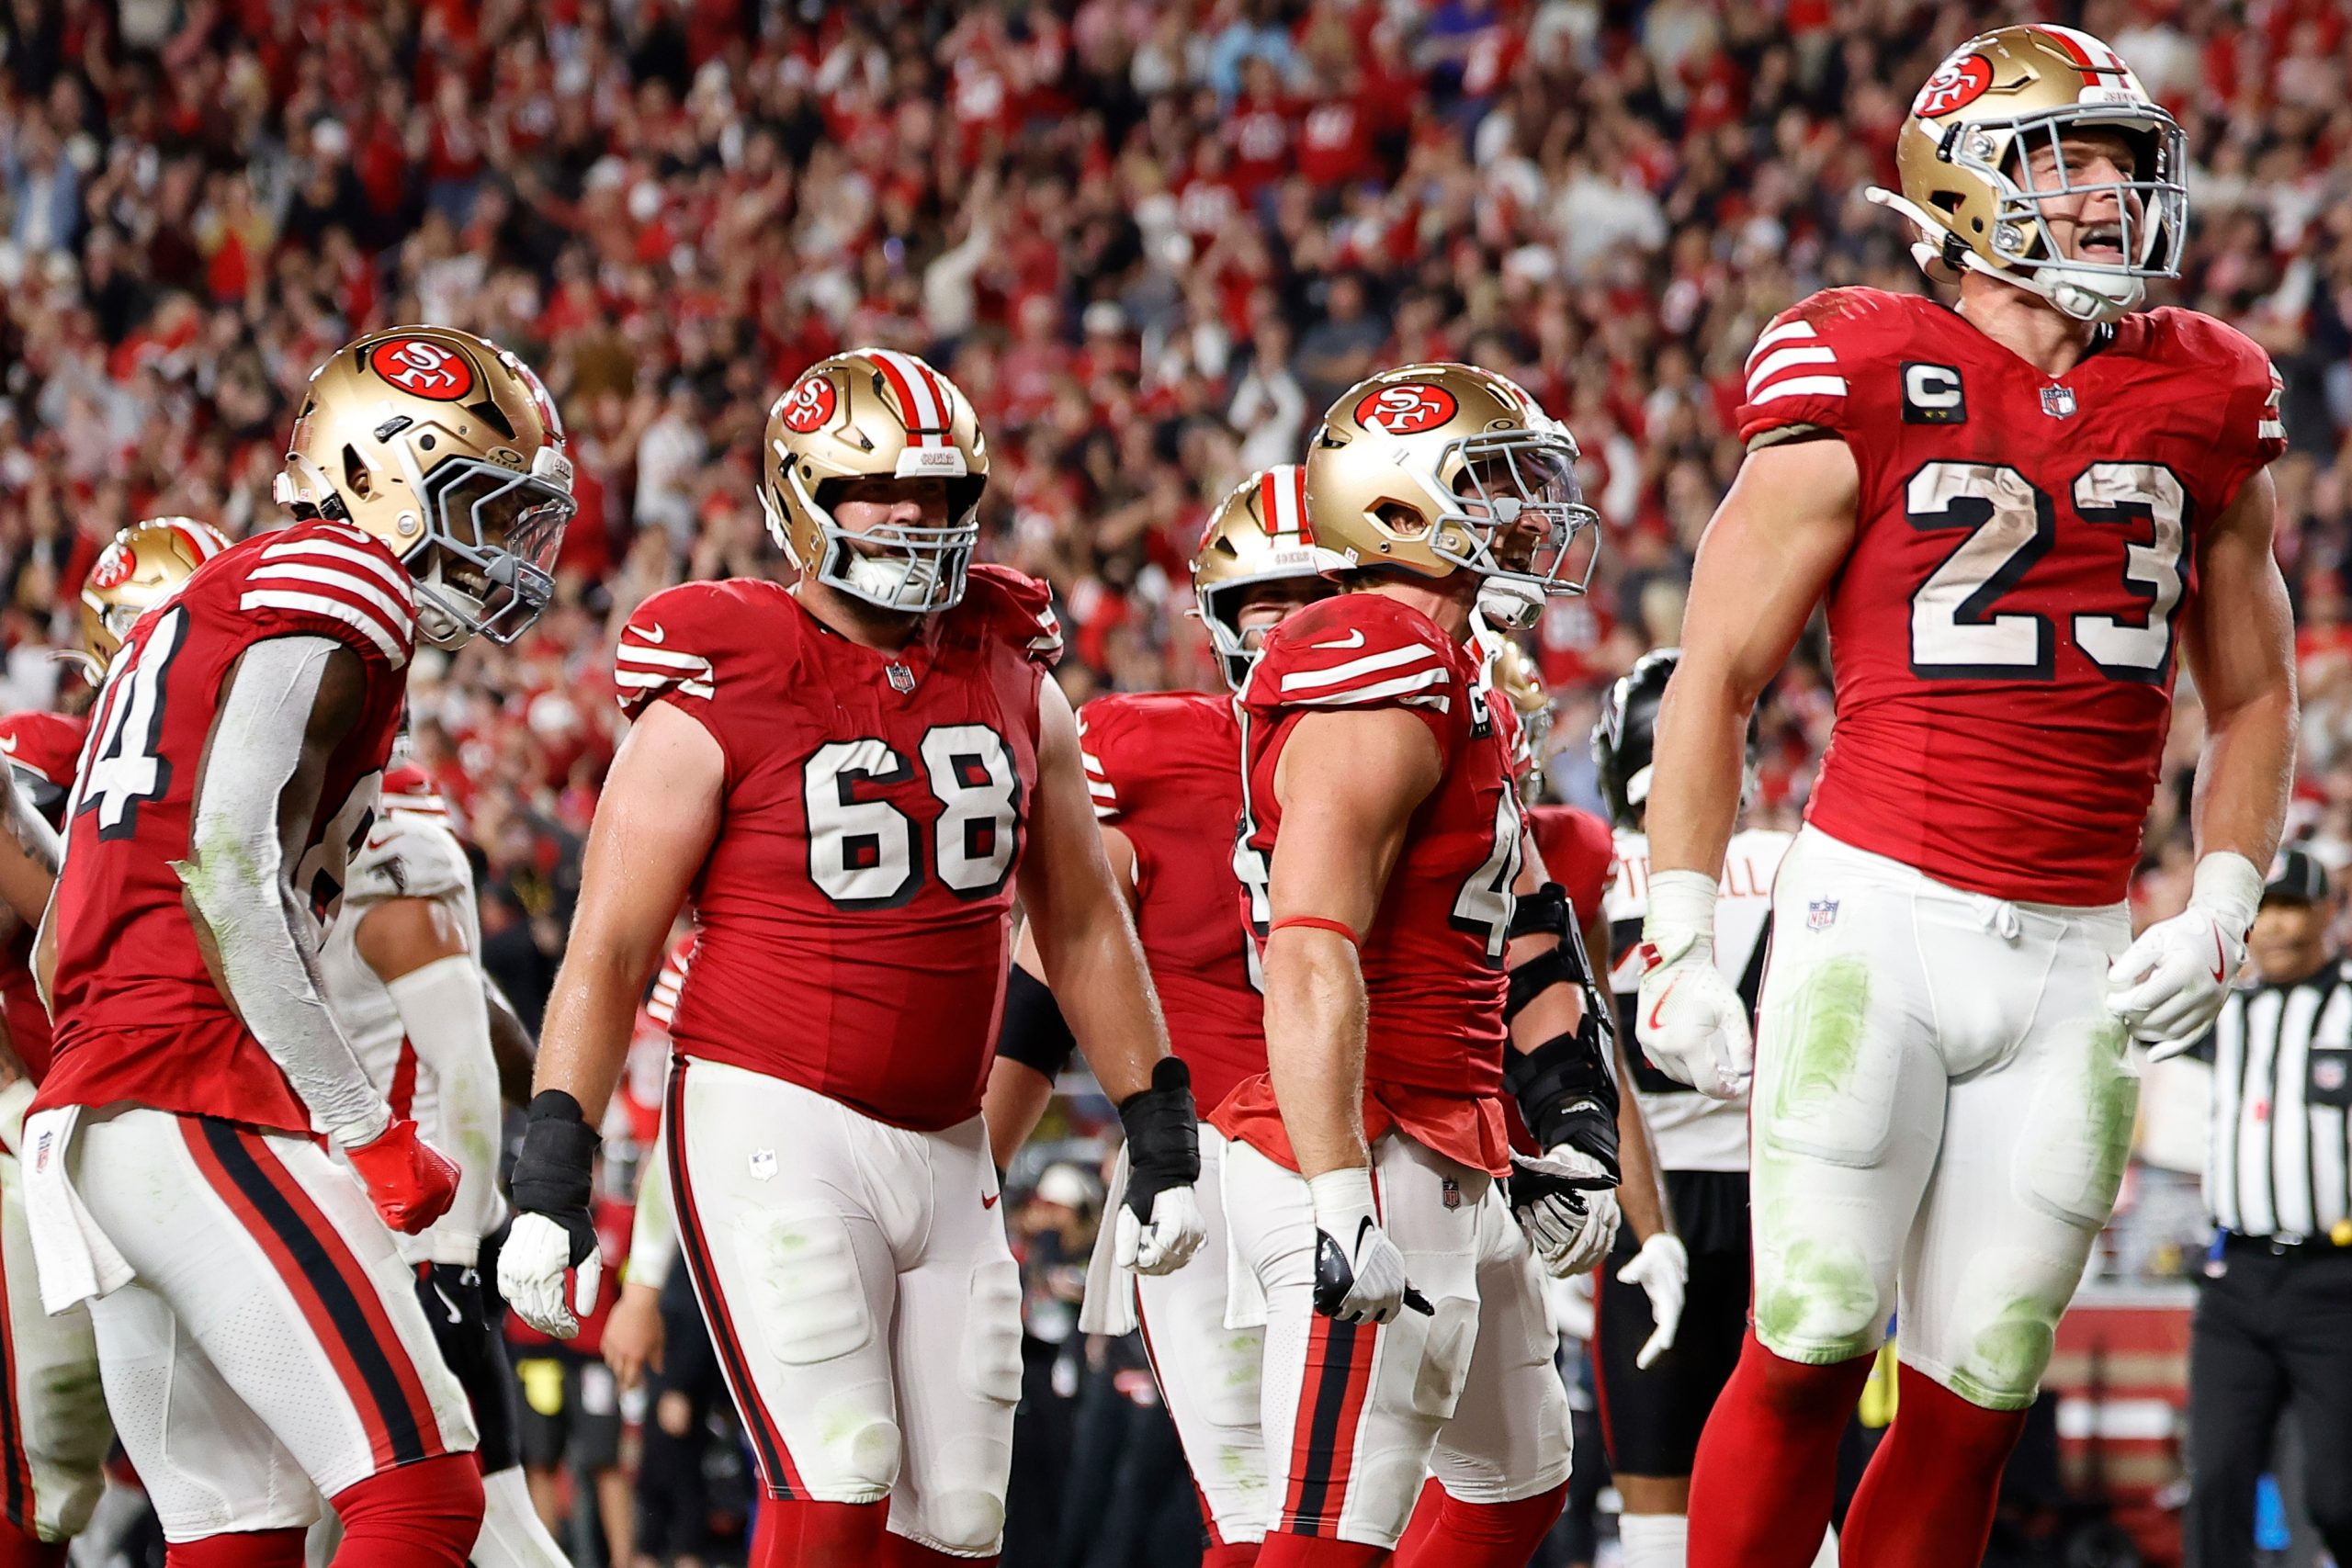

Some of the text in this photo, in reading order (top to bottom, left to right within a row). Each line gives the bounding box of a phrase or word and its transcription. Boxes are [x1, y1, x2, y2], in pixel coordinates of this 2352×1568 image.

[389, 341, 458, 389] SF
[1905, 364, 1962, 409] C
[787, 377, 828, 425] SF
[1374, 385, 1441, 430] SF
[1906, 461, 2190, 678] 23
[1468, 685, 1488, 725] C
[803, 723, 1020, 907] 68
